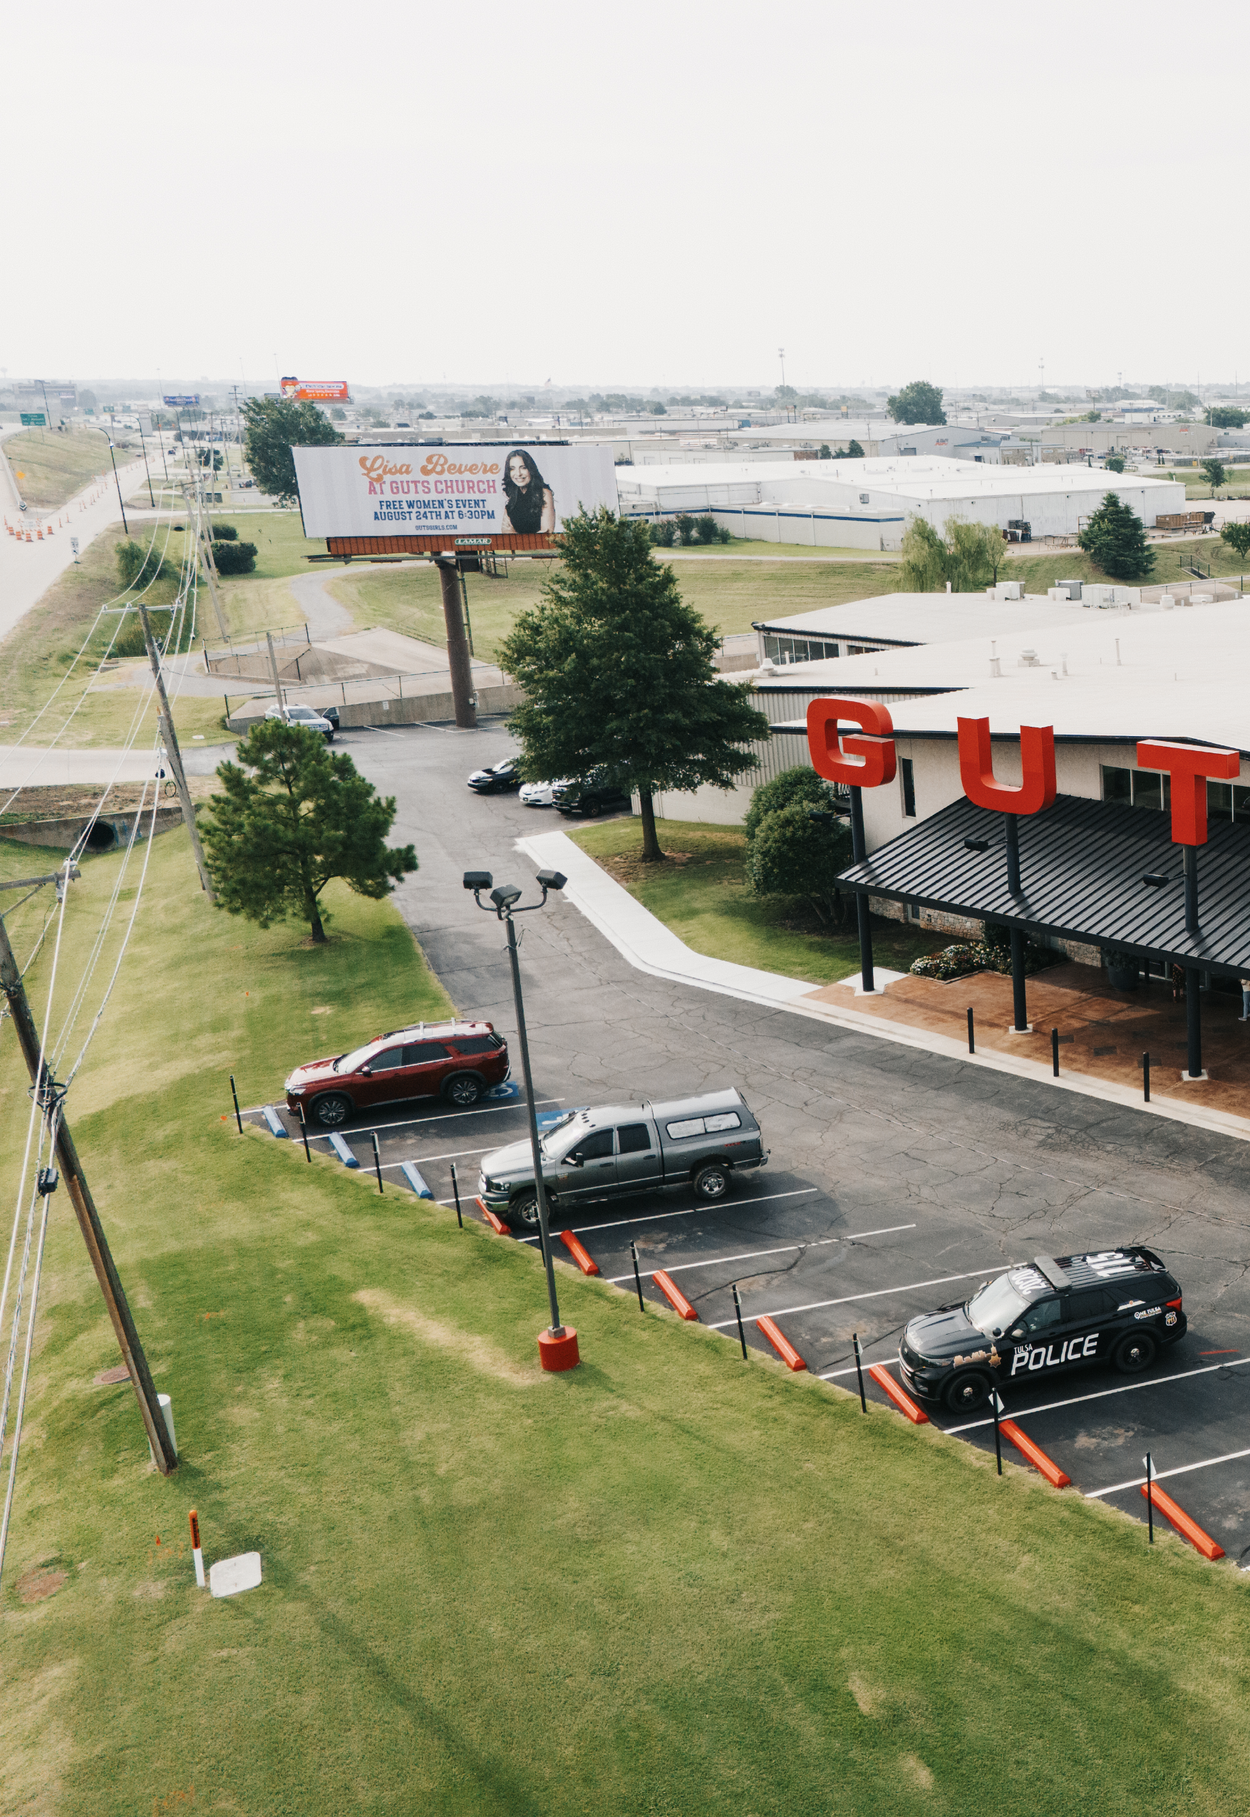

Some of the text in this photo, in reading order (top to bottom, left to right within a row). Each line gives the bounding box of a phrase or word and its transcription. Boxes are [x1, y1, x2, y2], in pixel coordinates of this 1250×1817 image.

[359, 454, 501, 482] Lisa Bevere
[368, 479, 497, 495] AT GUTS CHURCH
[379, 498, 487, 510] FREE WOMEN'S EVENT
[373, 510, 496, 521] AUGUST 24TH AT 6:30PM
[1012, 1268, 1047, 1295] 2020
[1010, 1333, 1100, 1376] POLICE
[1013, 1343, 1033, 1354] TULSA
